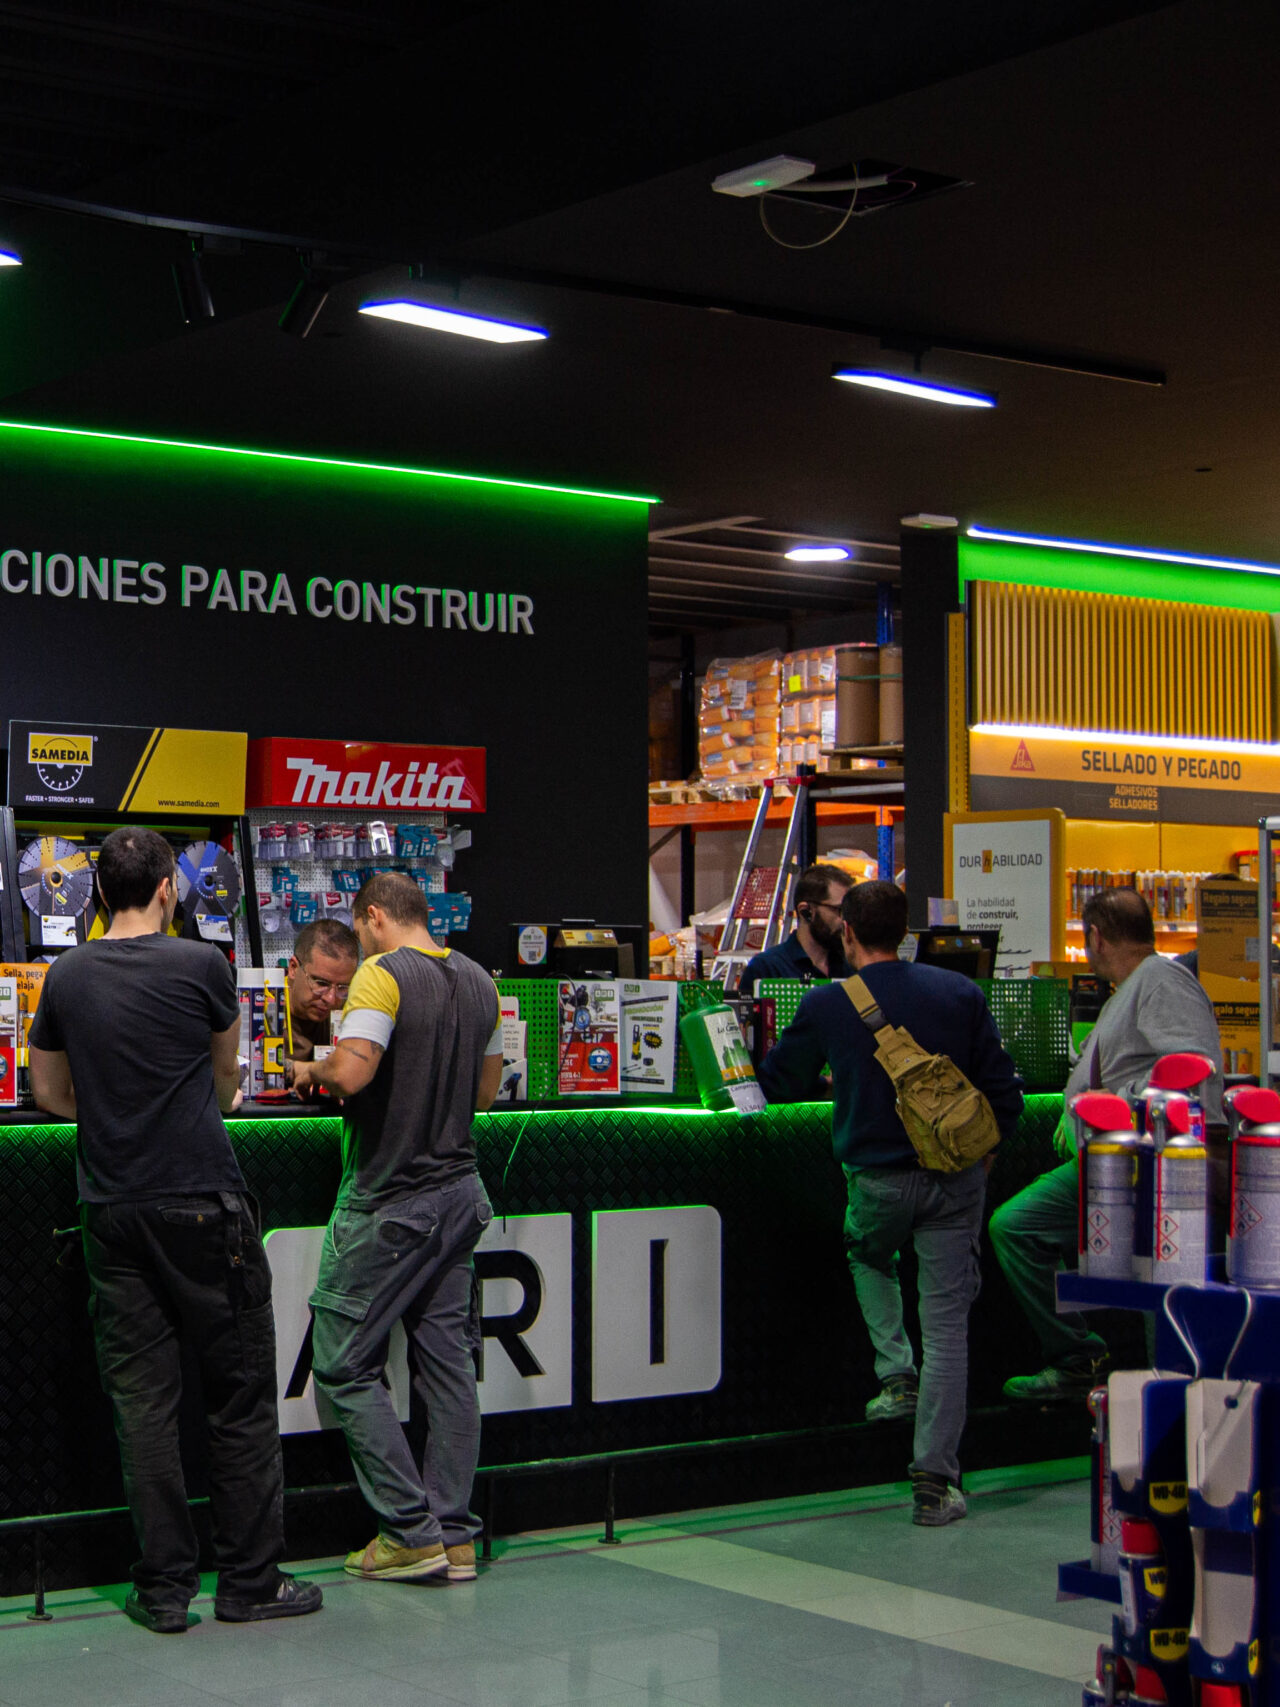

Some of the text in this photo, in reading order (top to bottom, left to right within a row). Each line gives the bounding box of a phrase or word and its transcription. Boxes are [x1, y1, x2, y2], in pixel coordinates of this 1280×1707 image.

[182, 564, 297, 615] PARA
[307, 576, 535, 635] CONSTRUIR
[30, 747, 90, 762] SAMEDIA
[1081, 749, 1241, 781] SELLADO Y PEGADO
[1114, 784, 1159, 798] ADHESIVOS
[25, 795, 45, 803] FASTER
[48, 796, 75, 804] STRONGER
[157, 797, 220, 809] www.samedia.com
[1108, 798, 1159, 811] SELLADORES
[966, 896, 1016, 908] La habilidad
[966, 910, 1019, 920] de construir,
[3, 968, 43, 980] Sella, pega
[1152, 1485, 1186, 1500] WD-40
[1153, 1631, 1187, 1646] WD-40
